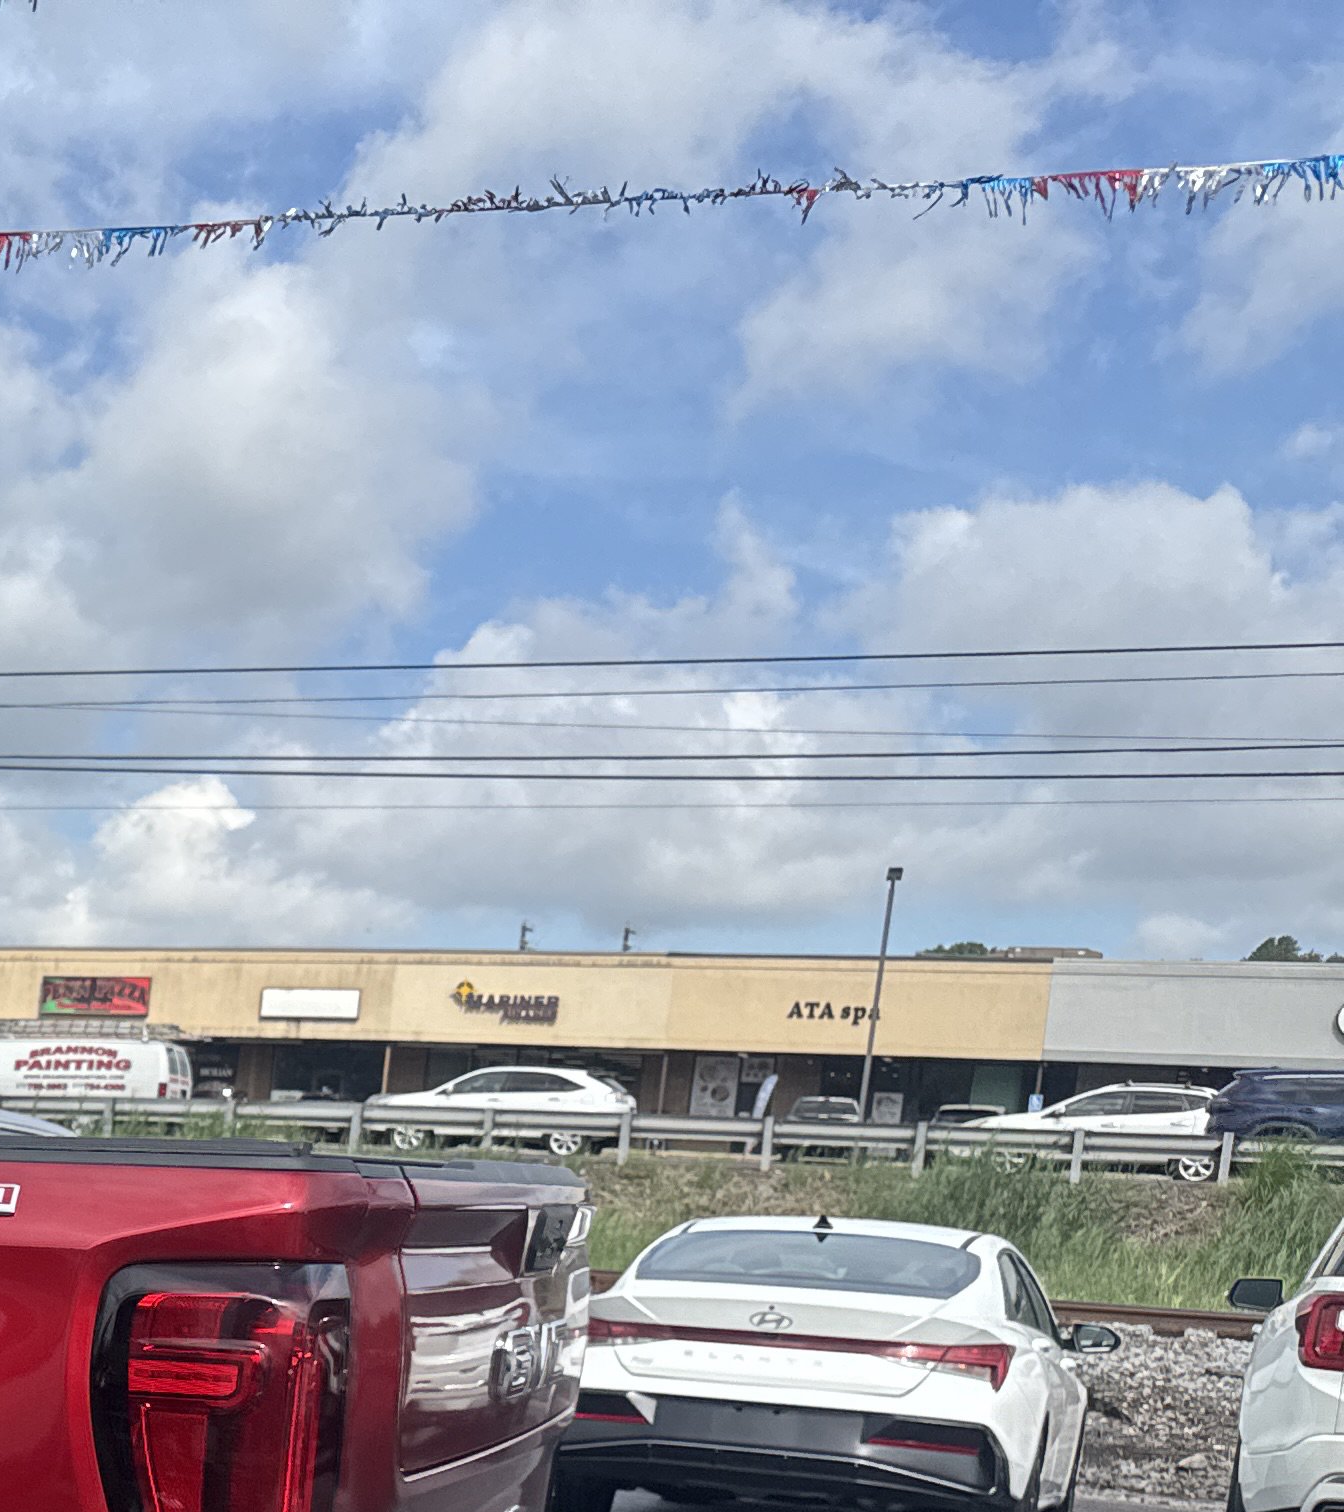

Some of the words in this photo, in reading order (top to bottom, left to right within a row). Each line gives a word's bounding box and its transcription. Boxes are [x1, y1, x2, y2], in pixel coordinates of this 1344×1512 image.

[466, 992, 560, 1008] MARINER
[787, 1001, 835, 1019] ATA
[14, 1059, 132, 1071] PAINTING
[684, 1348, 824, 1368] ELANTR
